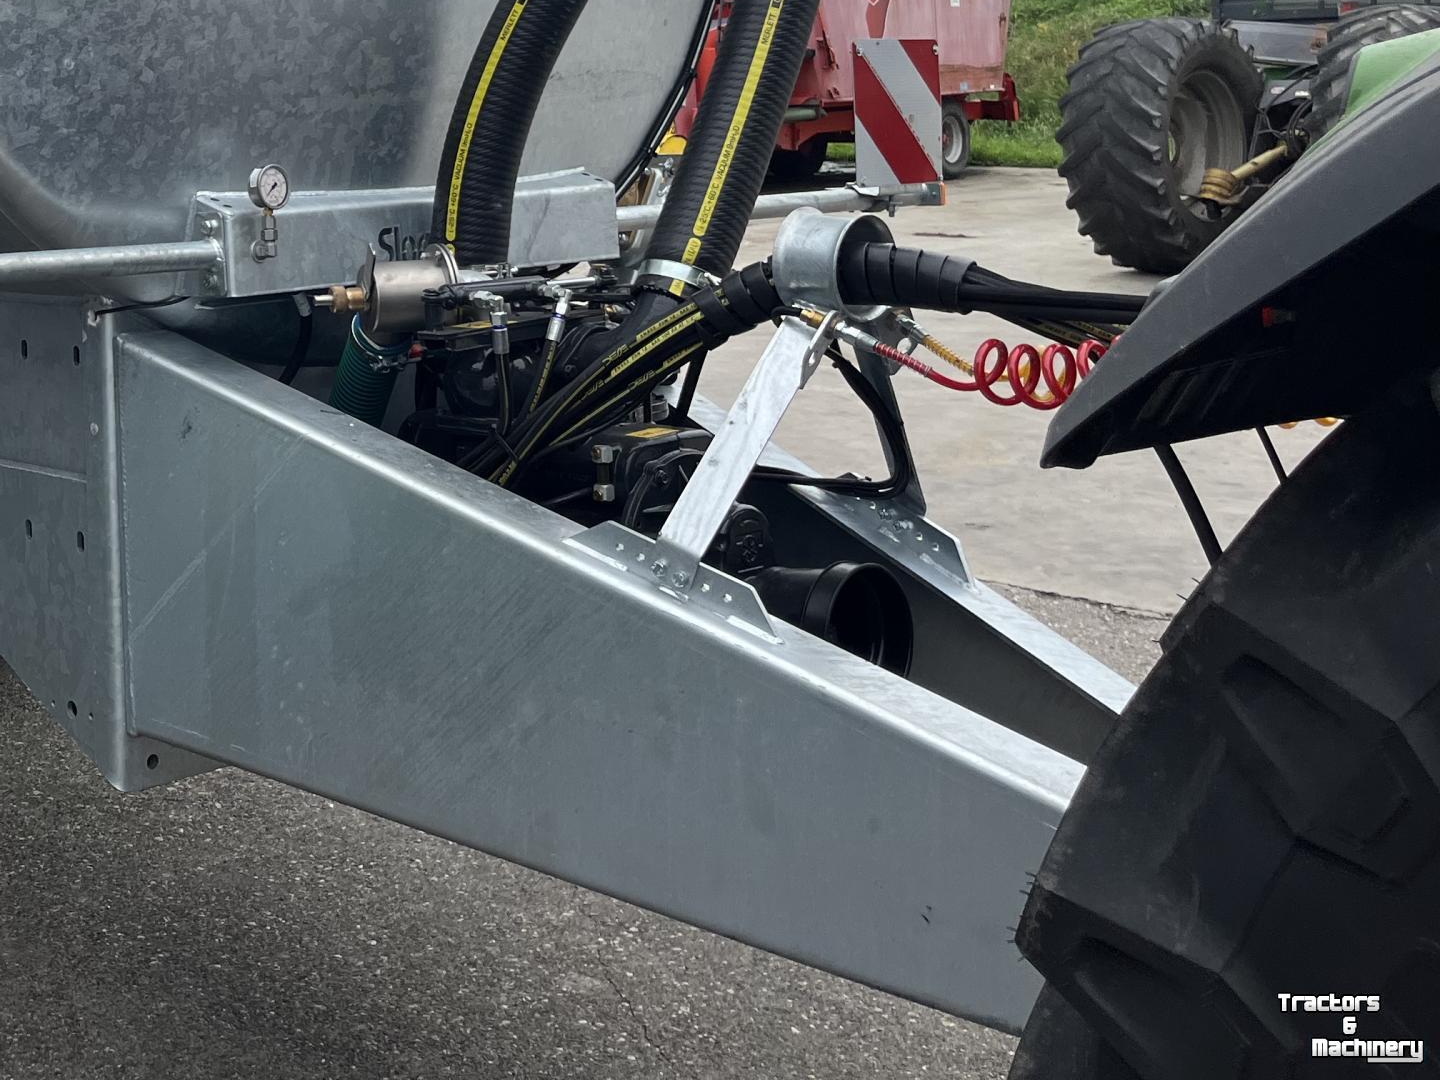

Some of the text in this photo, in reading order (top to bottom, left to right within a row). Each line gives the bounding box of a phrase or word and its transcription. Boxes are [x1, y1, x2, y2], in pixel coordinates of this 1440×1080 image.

[500, 10, 519, 41] MERLETT
[761, 13, 777, 45] MERLETT
[454, 149, 466, 180] VACUUM
[716, 149, 731, 180] VACUUM
